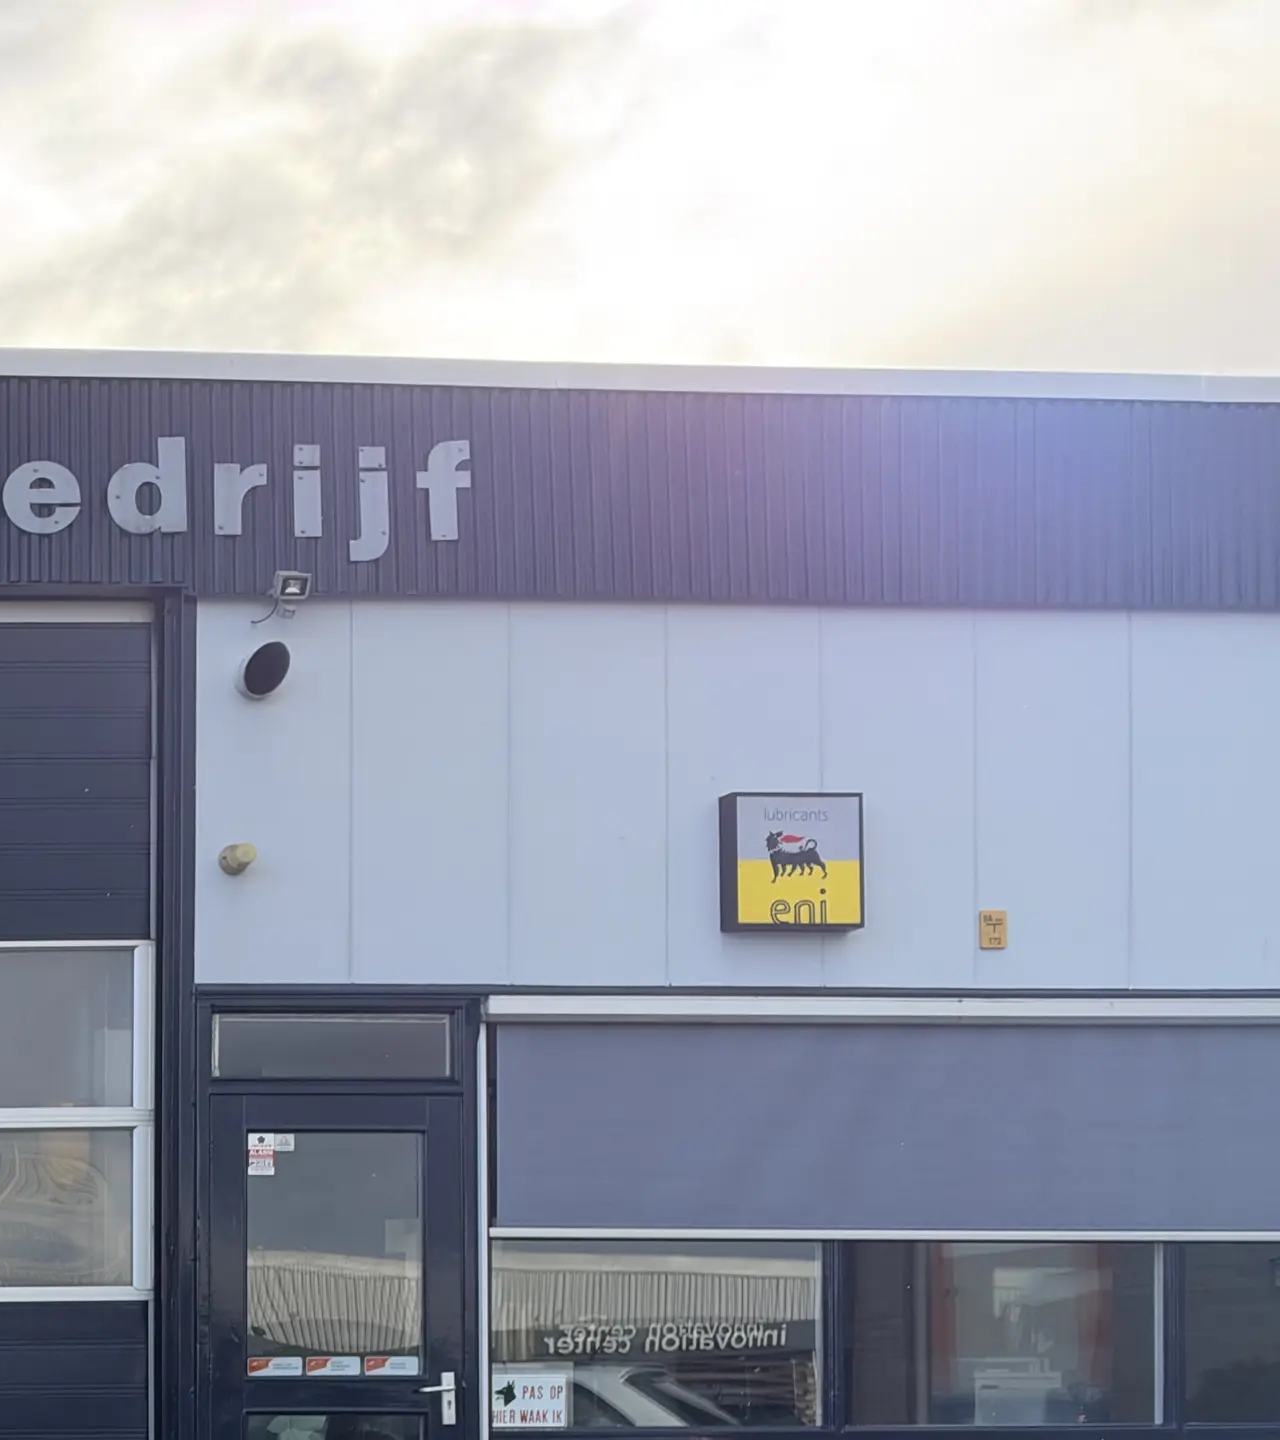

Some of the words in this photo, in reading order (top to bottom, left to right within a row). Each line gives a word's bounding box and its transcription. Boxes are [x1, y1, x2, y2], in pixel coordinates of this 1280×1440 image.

[764, 807, 829, 822] lubricants
[770, 888, 828, 924] eni
[522, 1385, 543, 1399] PAS
[549, 1385, 563, 1399] OP
[492, 1409, 516, 1424] HIER
[520, 1409, 548, 1424] WAAK
[552, 1409, 563, 1423] IK
